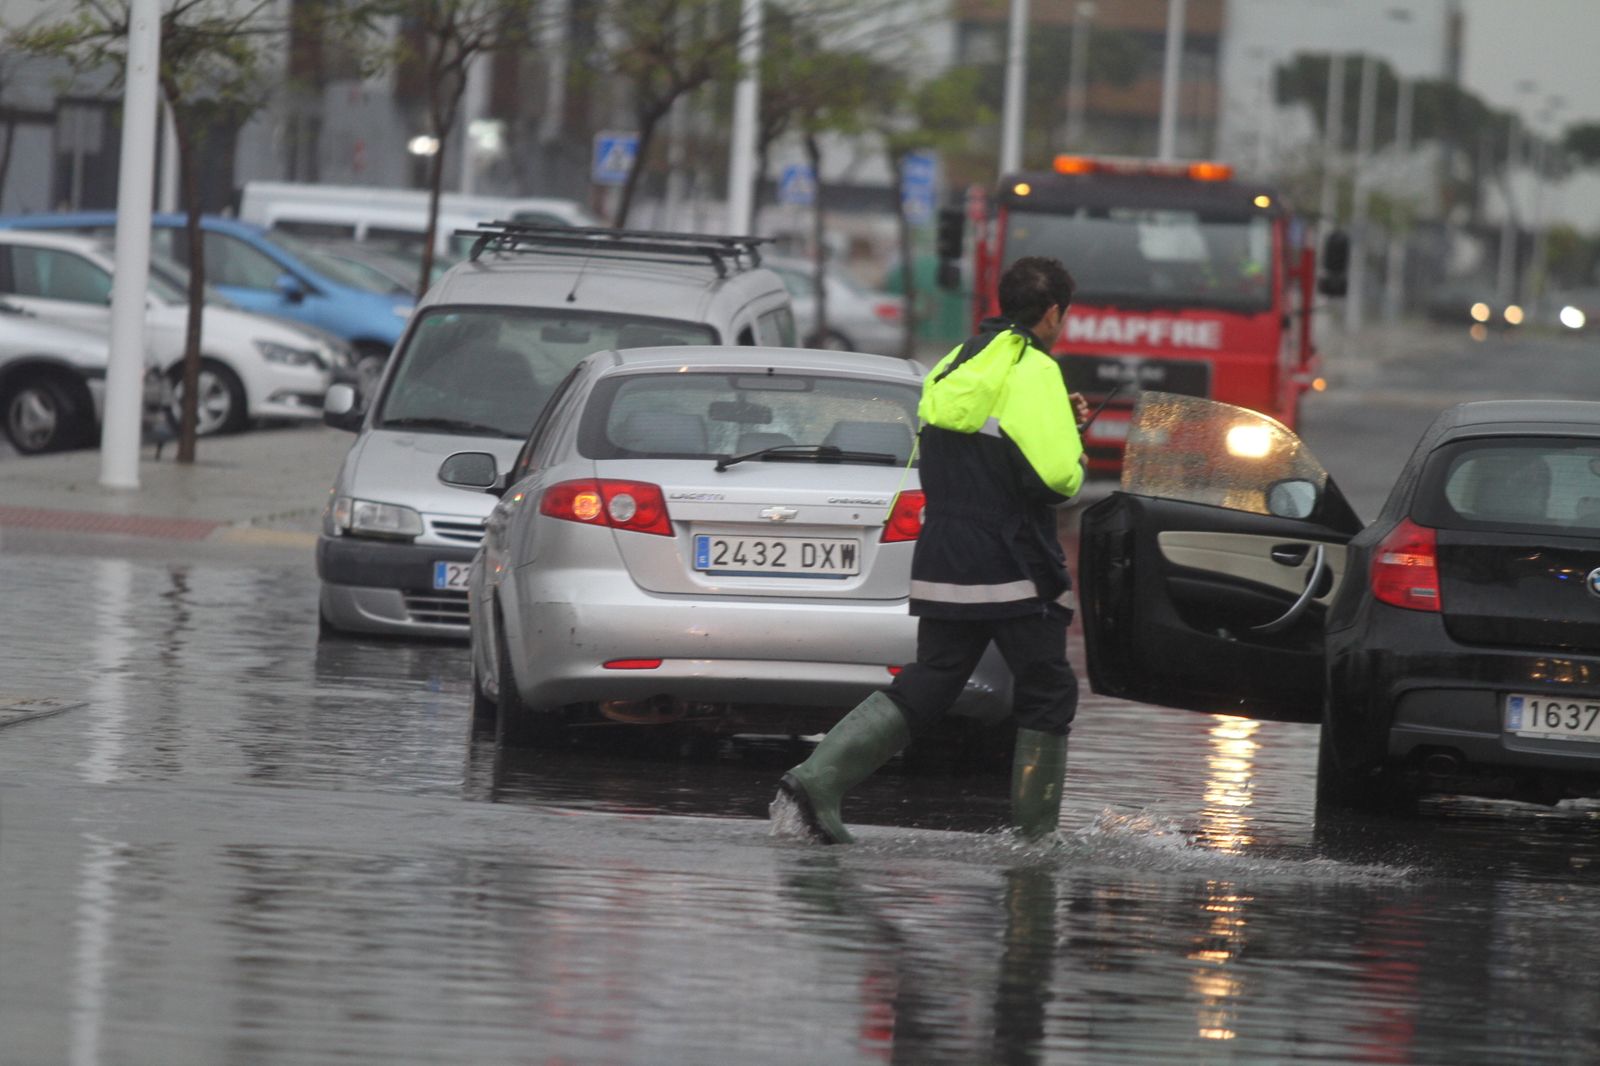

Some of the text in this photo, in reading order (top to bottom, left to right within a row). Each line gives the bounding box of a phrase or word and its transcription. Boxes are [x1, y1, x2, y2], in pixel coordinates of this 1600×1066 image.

[1065, 314, 1222, 349] MAPFRE
[712, 540, 856, 569] 2432 DXW
[1530, 700, 1600, 732] 1637
